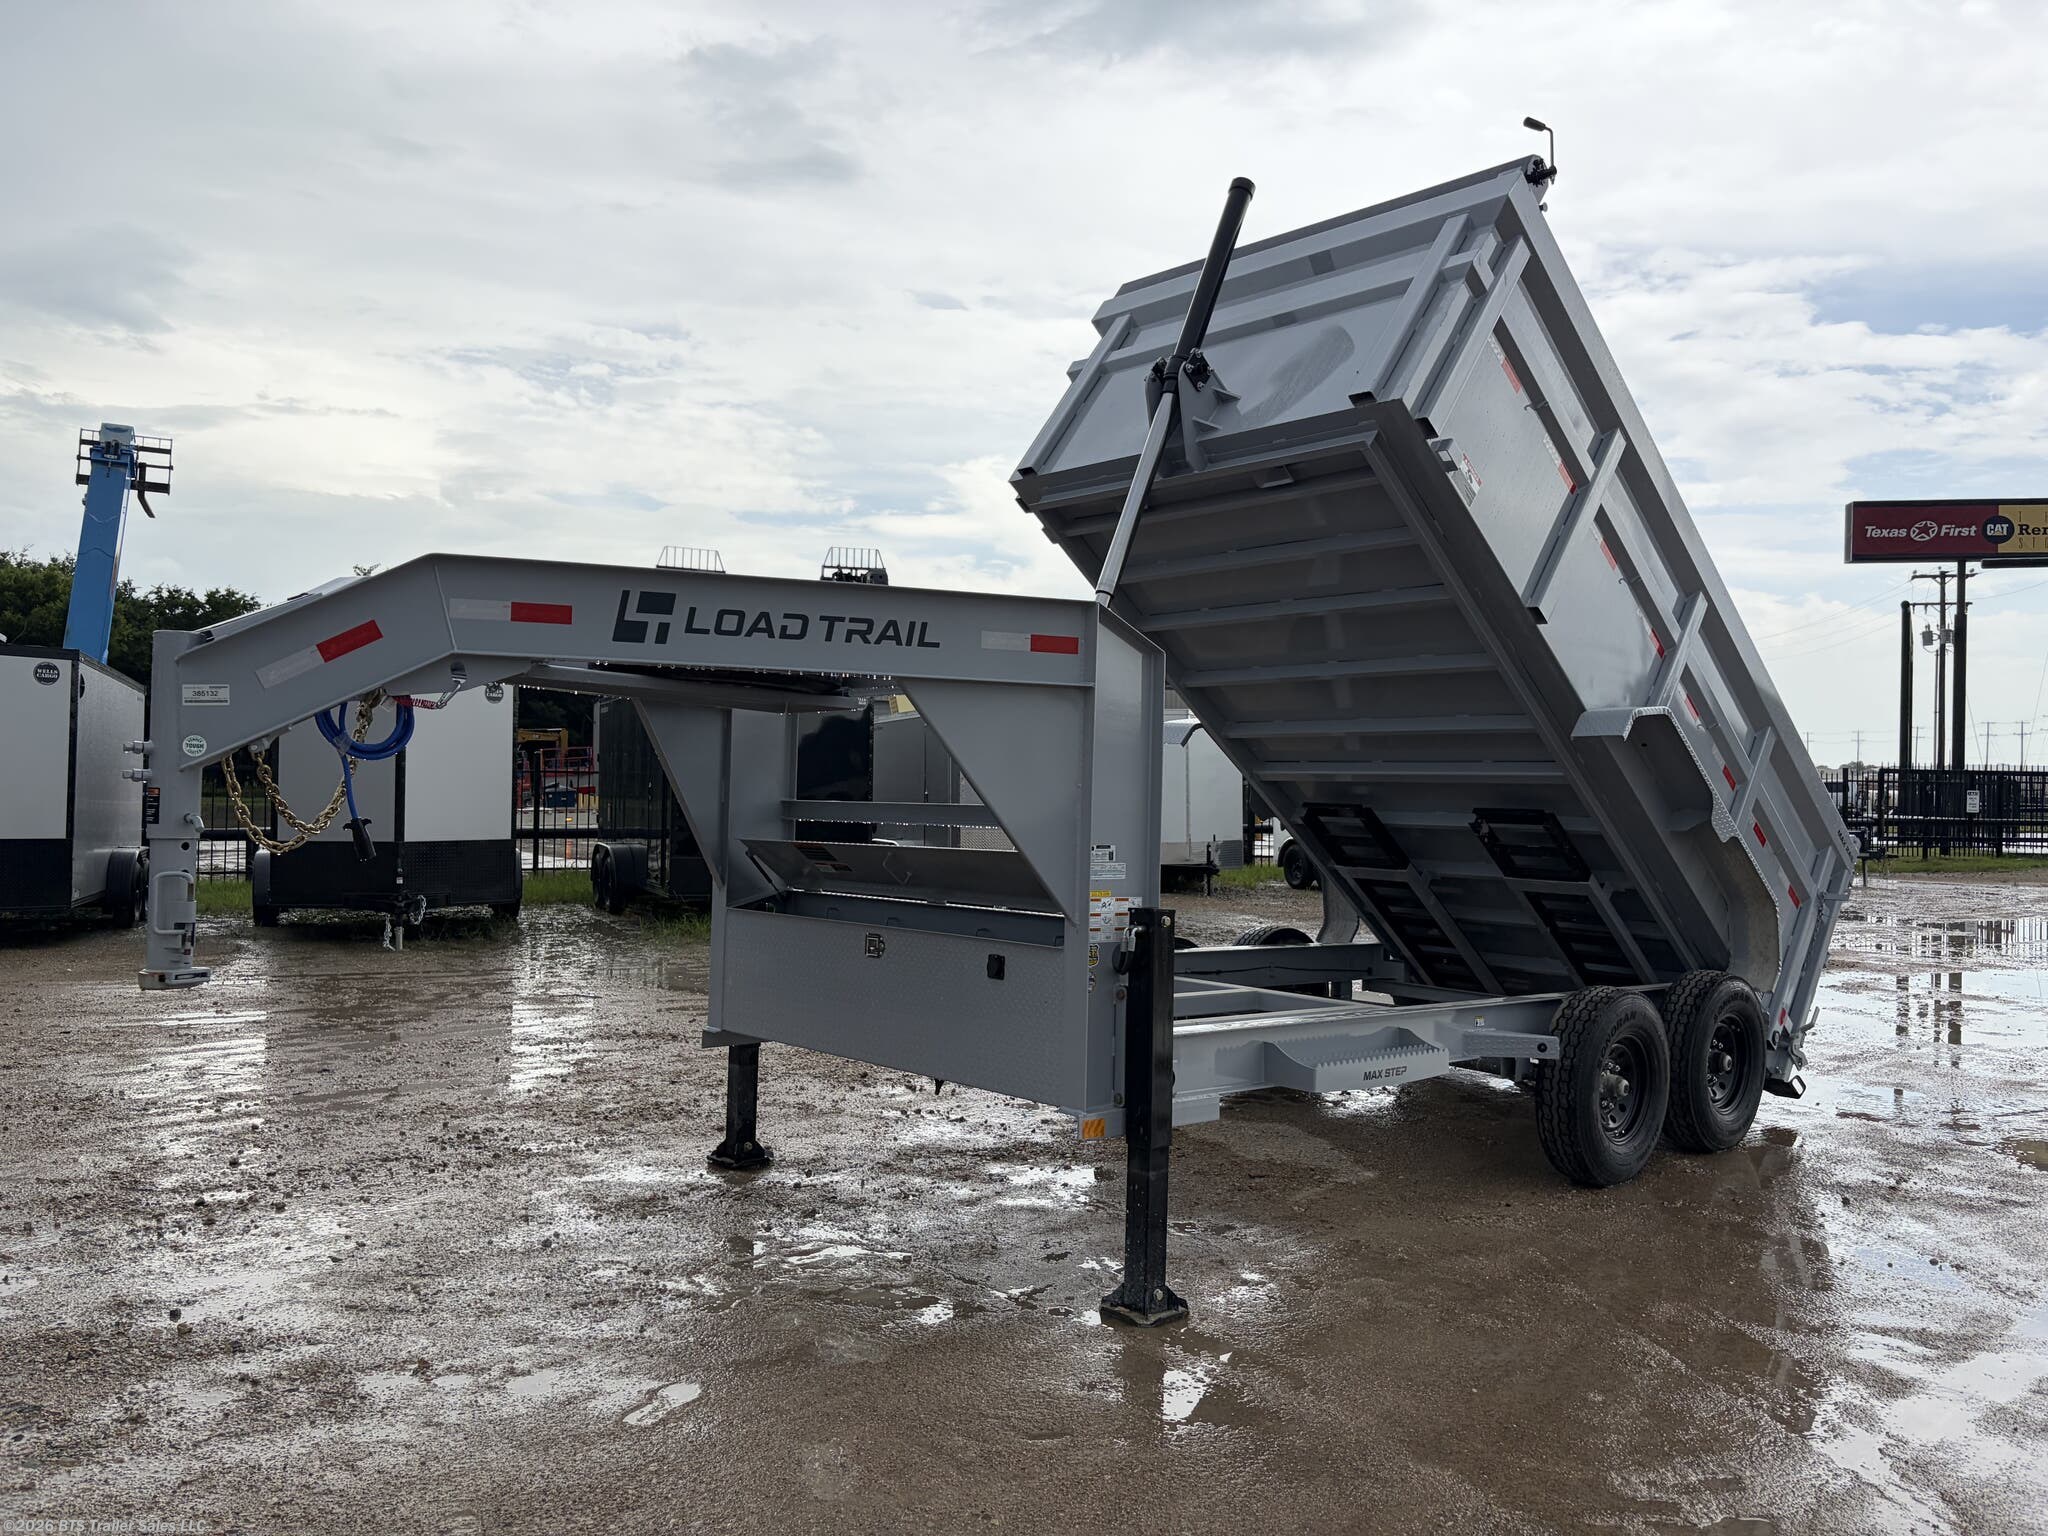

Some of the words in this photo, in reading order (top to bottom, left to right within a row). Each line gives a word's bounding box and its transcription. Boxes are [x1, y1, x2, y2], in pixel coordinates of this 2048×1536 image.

[1864, 525, 1907, 538] Texas
[1939, 524, 1977, 537] First
[1986, 523, 2009, 536] CAT
[684, 606, 810, 641] LOAD
[818, 614, 941, 649] TRAIL
[1363, 1068, 1383, 1081] MAX
[1384, 1066, 1407, 1078] STEP
